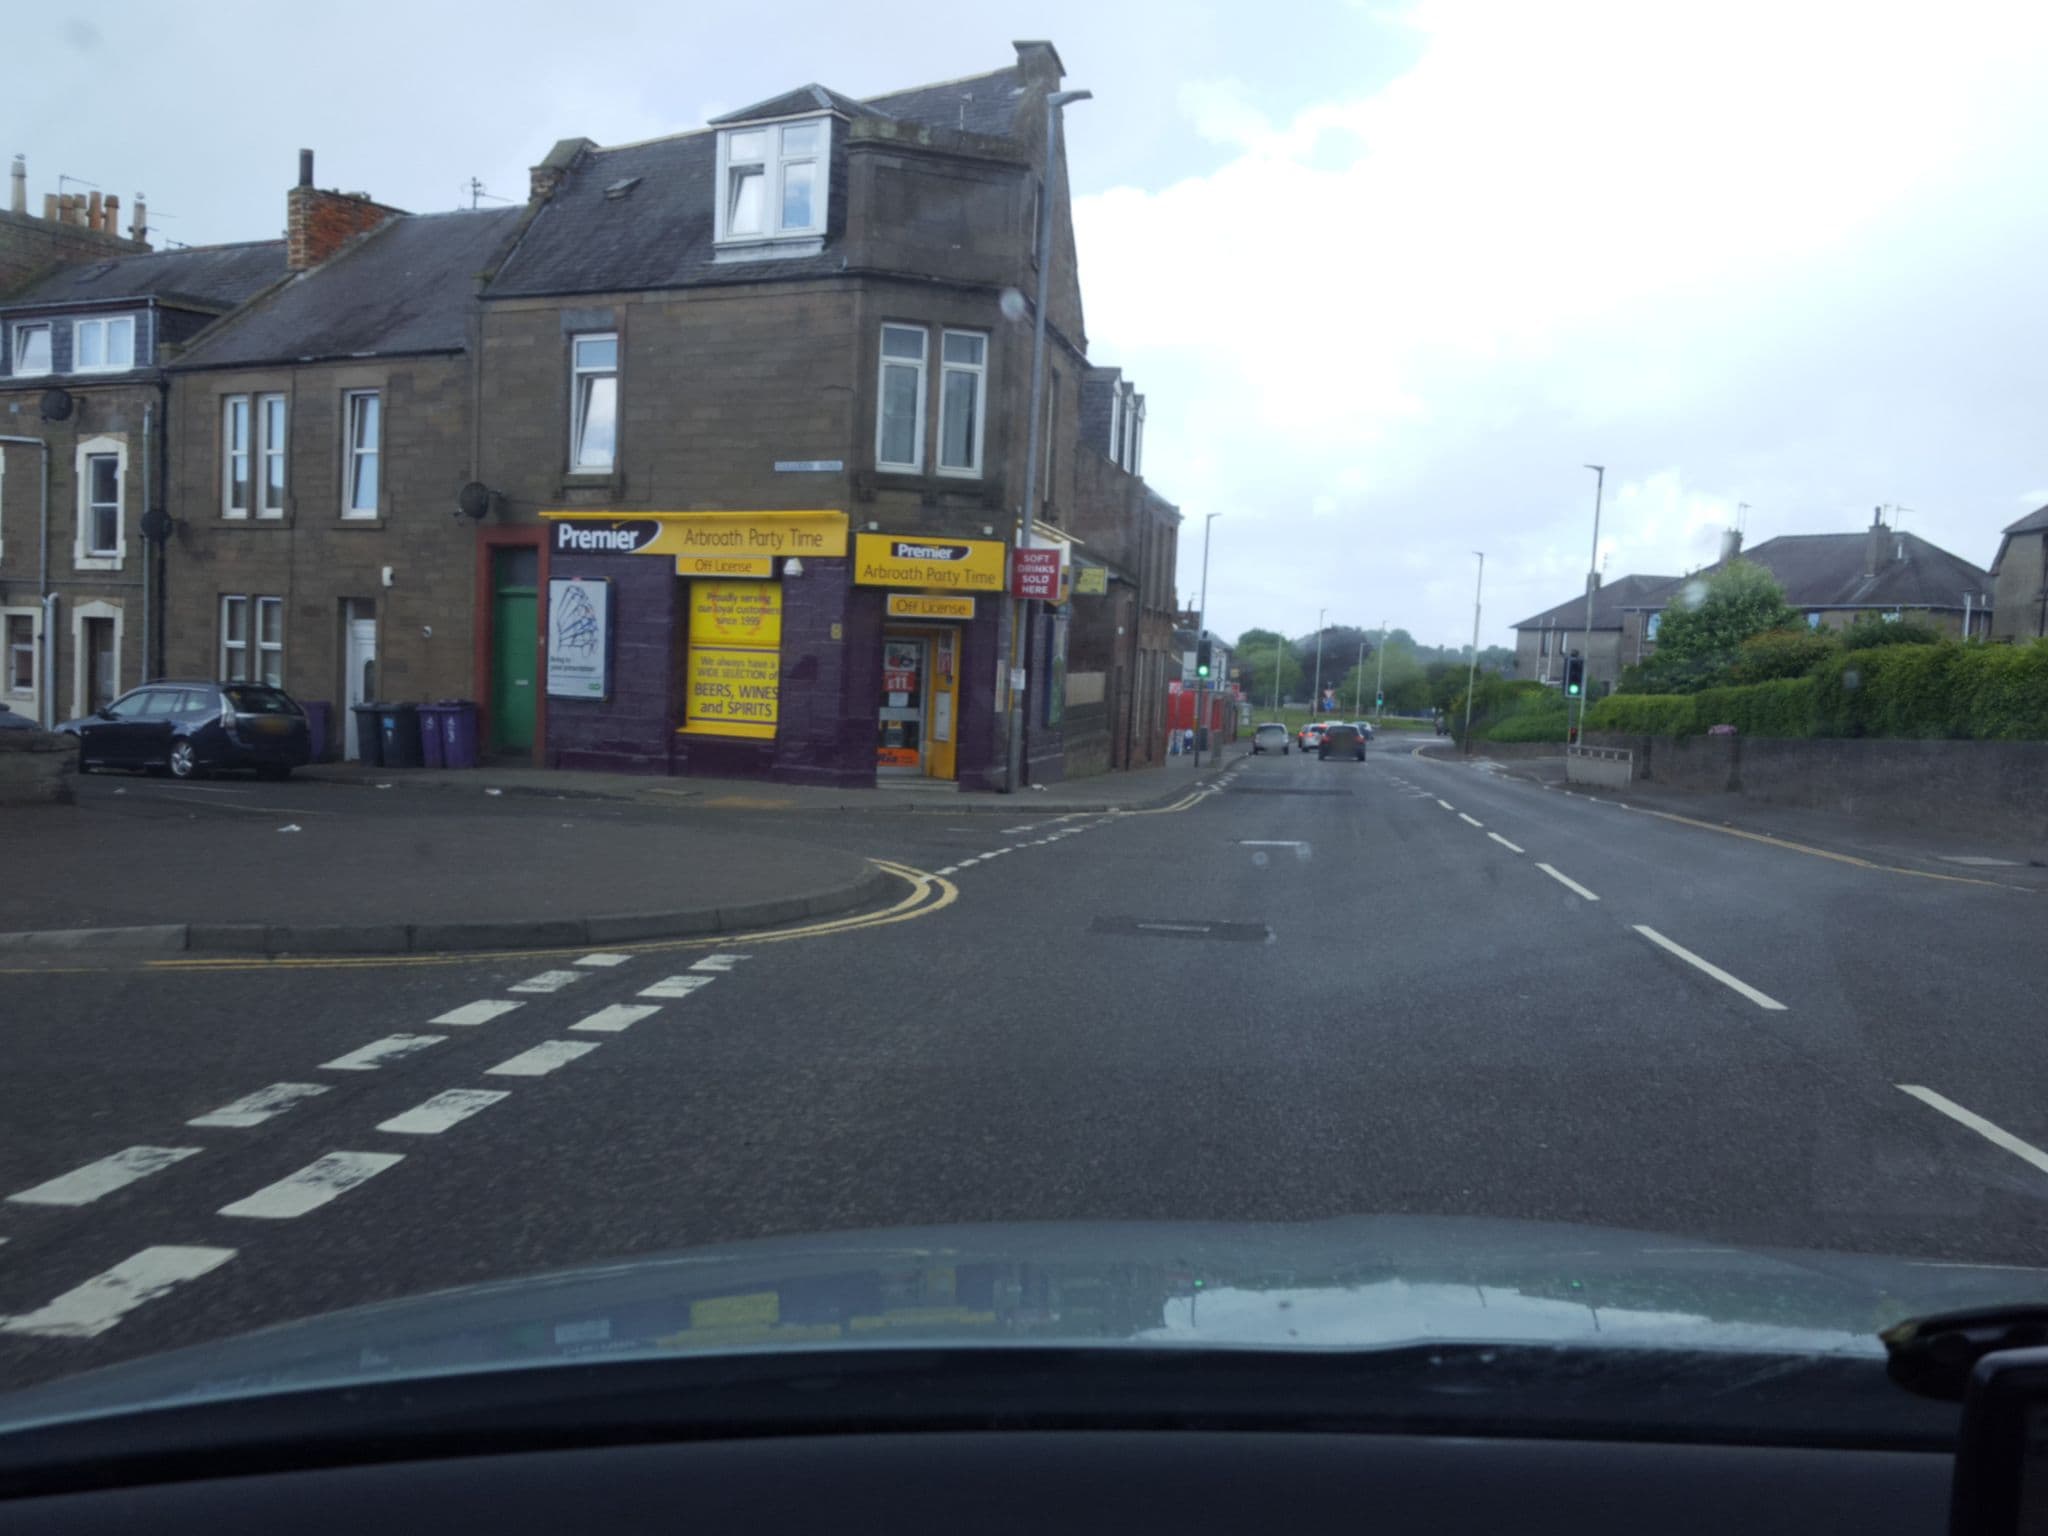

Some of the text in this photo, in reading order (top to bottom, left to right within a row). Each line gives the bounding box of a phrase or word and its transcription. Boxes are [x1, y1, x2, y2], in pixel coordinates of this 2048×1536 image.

[558, 522, 639, 549] Premier
[684, 528, 823, 553] Arbroath Party Time
[897, 543, 953, 559] Premier
[1023, 554, 1050, 562] SOFT
[694, 558, 753, 572] Off License
[1017, 564, 1055, 574] DRINKS
[864, 564, 996, 585] Arbroath Party Time
[1022, 575, 1050, 584] SOLD
[1022, 585, 1049, 594] HERE
[896, 599, 966, 615] Off License
[722, 669, 766, 679] SELECTION
[695, 683, 780, 700] BEERS, WINES
[700, 699, 773, 717] and SPIRITS
